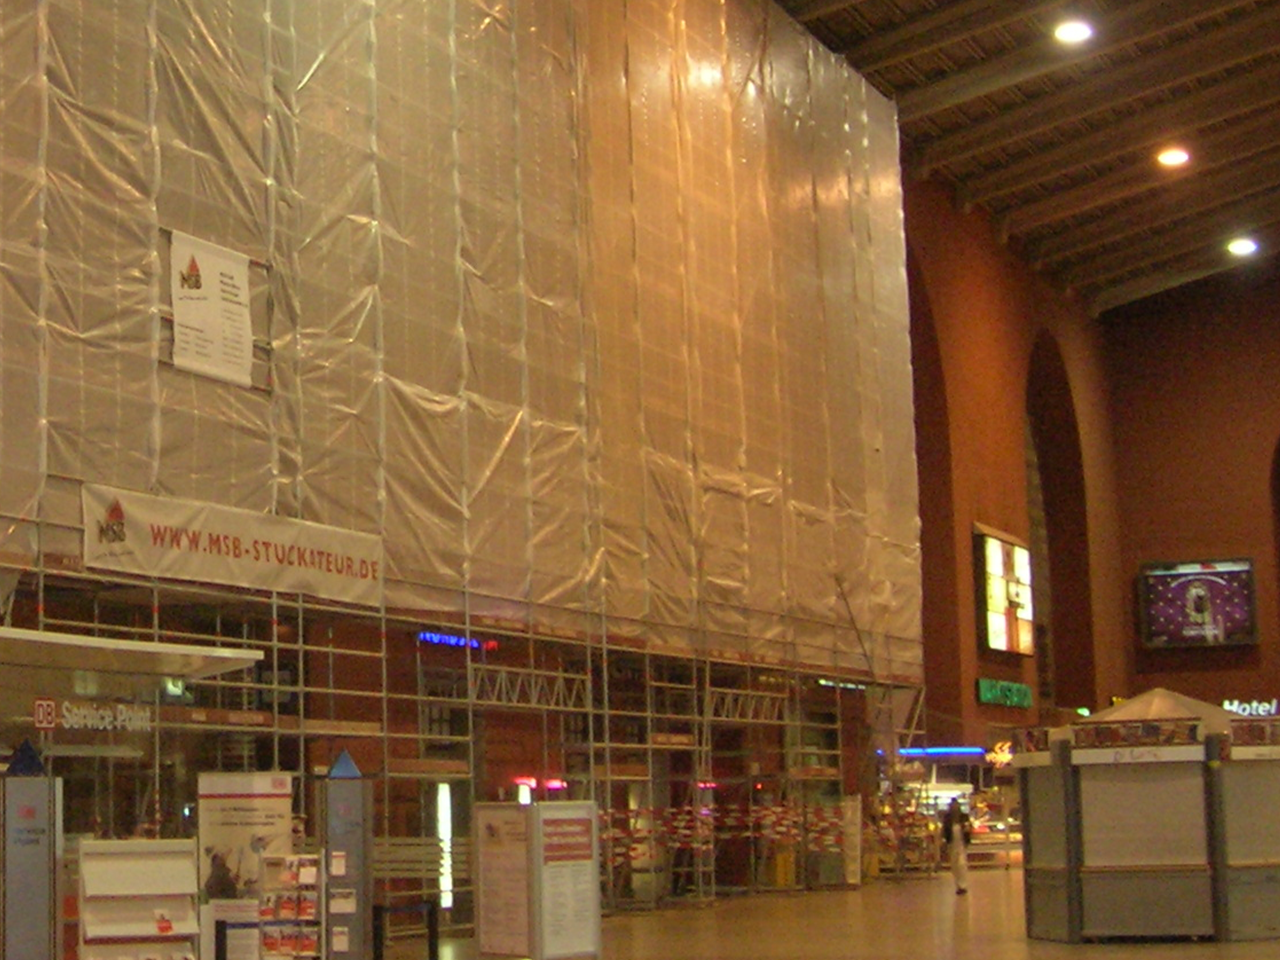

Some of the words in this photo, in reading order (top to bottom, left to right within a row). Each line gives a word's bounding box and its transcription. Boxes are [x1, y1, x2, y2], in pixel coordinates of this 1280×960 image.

[98, 520, 126, 543] MSB
[150, 523, 379, 581] WWW.MSB-STUCKATEUR.DE
[1223, 698, 1278, 716] Hotel
